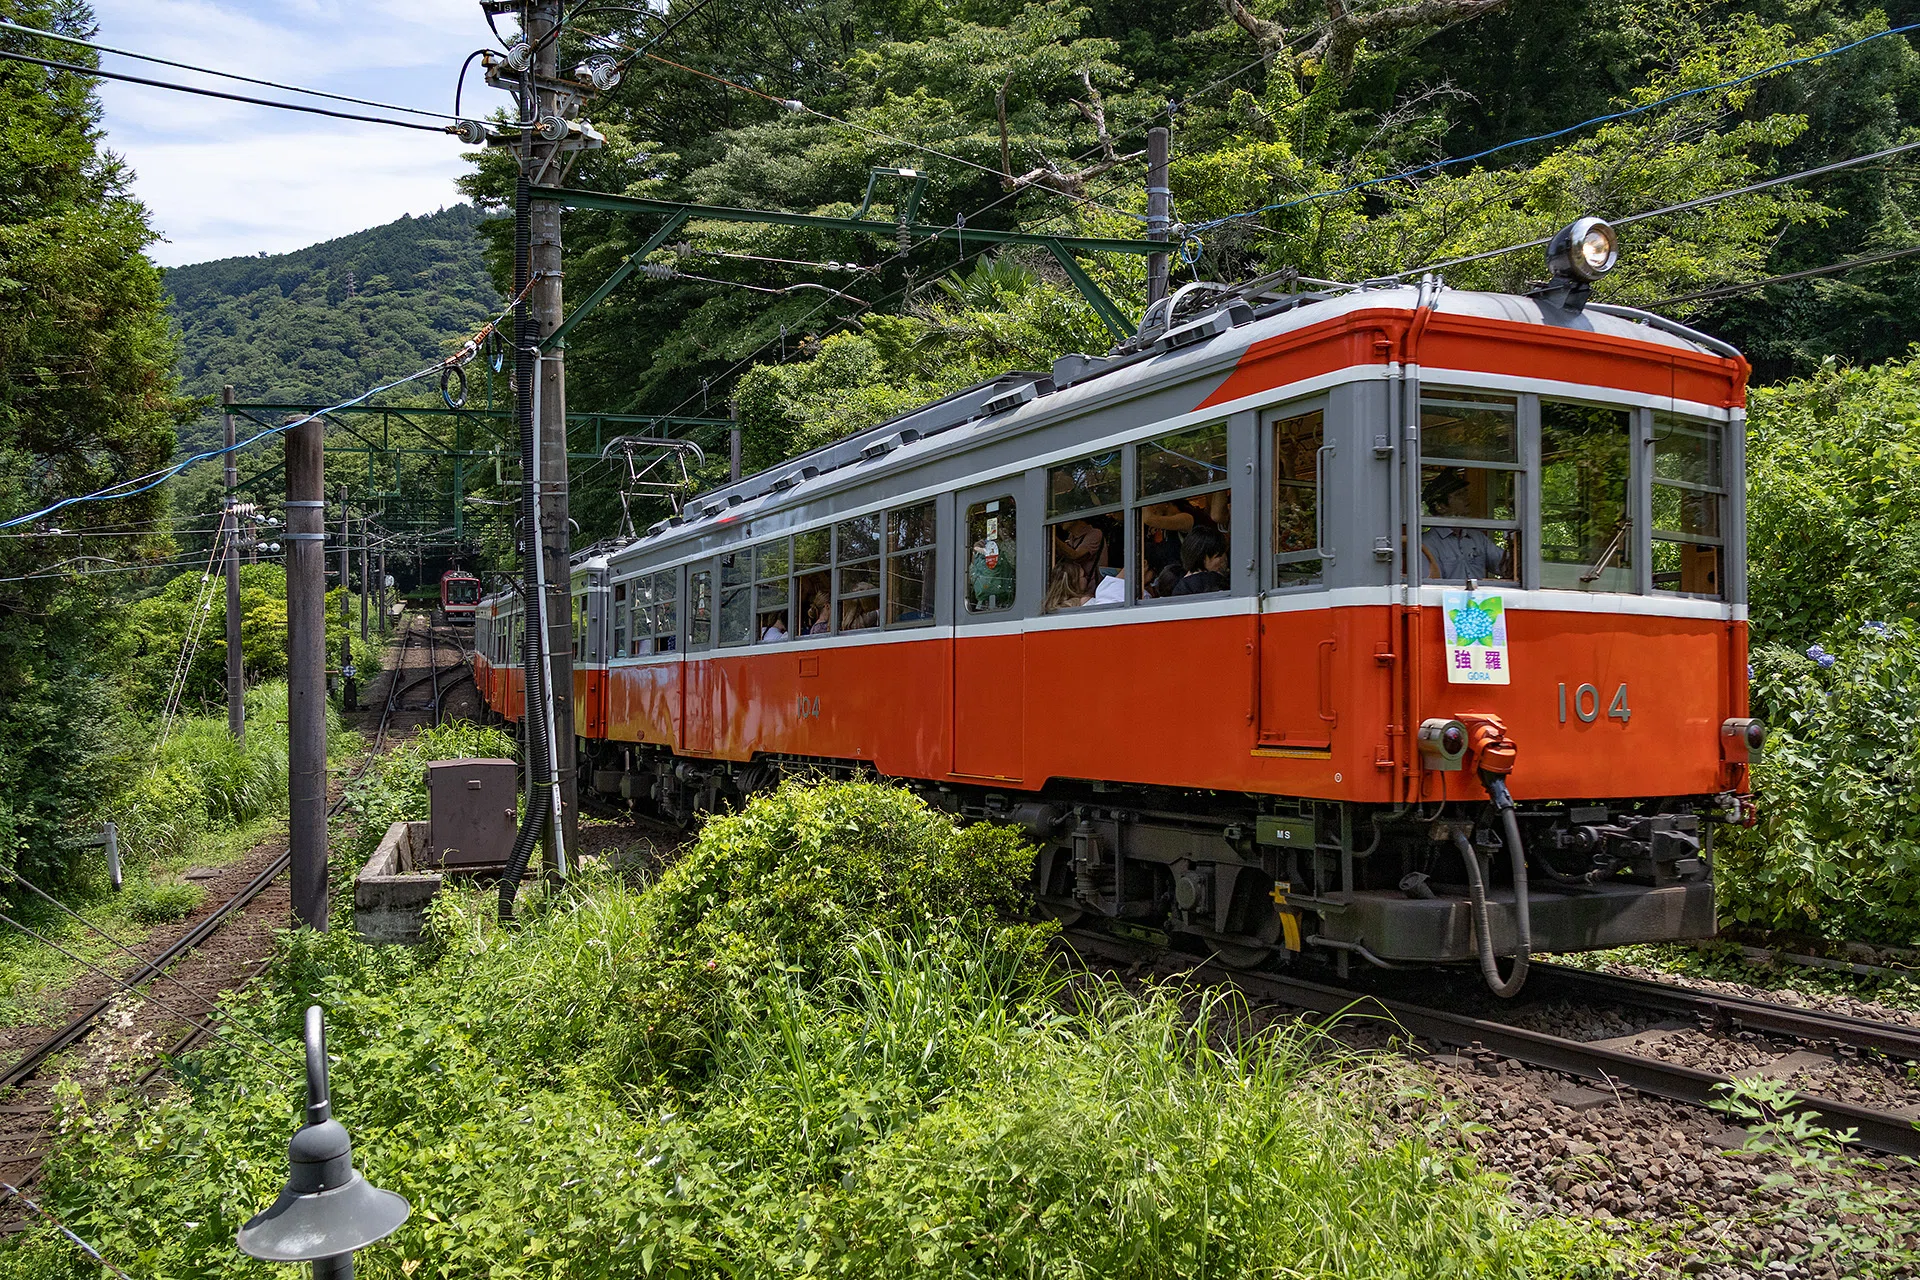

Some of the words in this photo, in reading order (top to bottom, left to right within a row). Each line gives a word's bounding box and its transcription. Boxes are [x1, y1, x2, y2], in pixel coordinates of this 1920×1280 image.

[1467, 671, 1491, 681] GORA
[796, 695, 820, 719] 104
[1558, 682, 1632, 723] 104
[1276, 829, 1291, 839] MS
